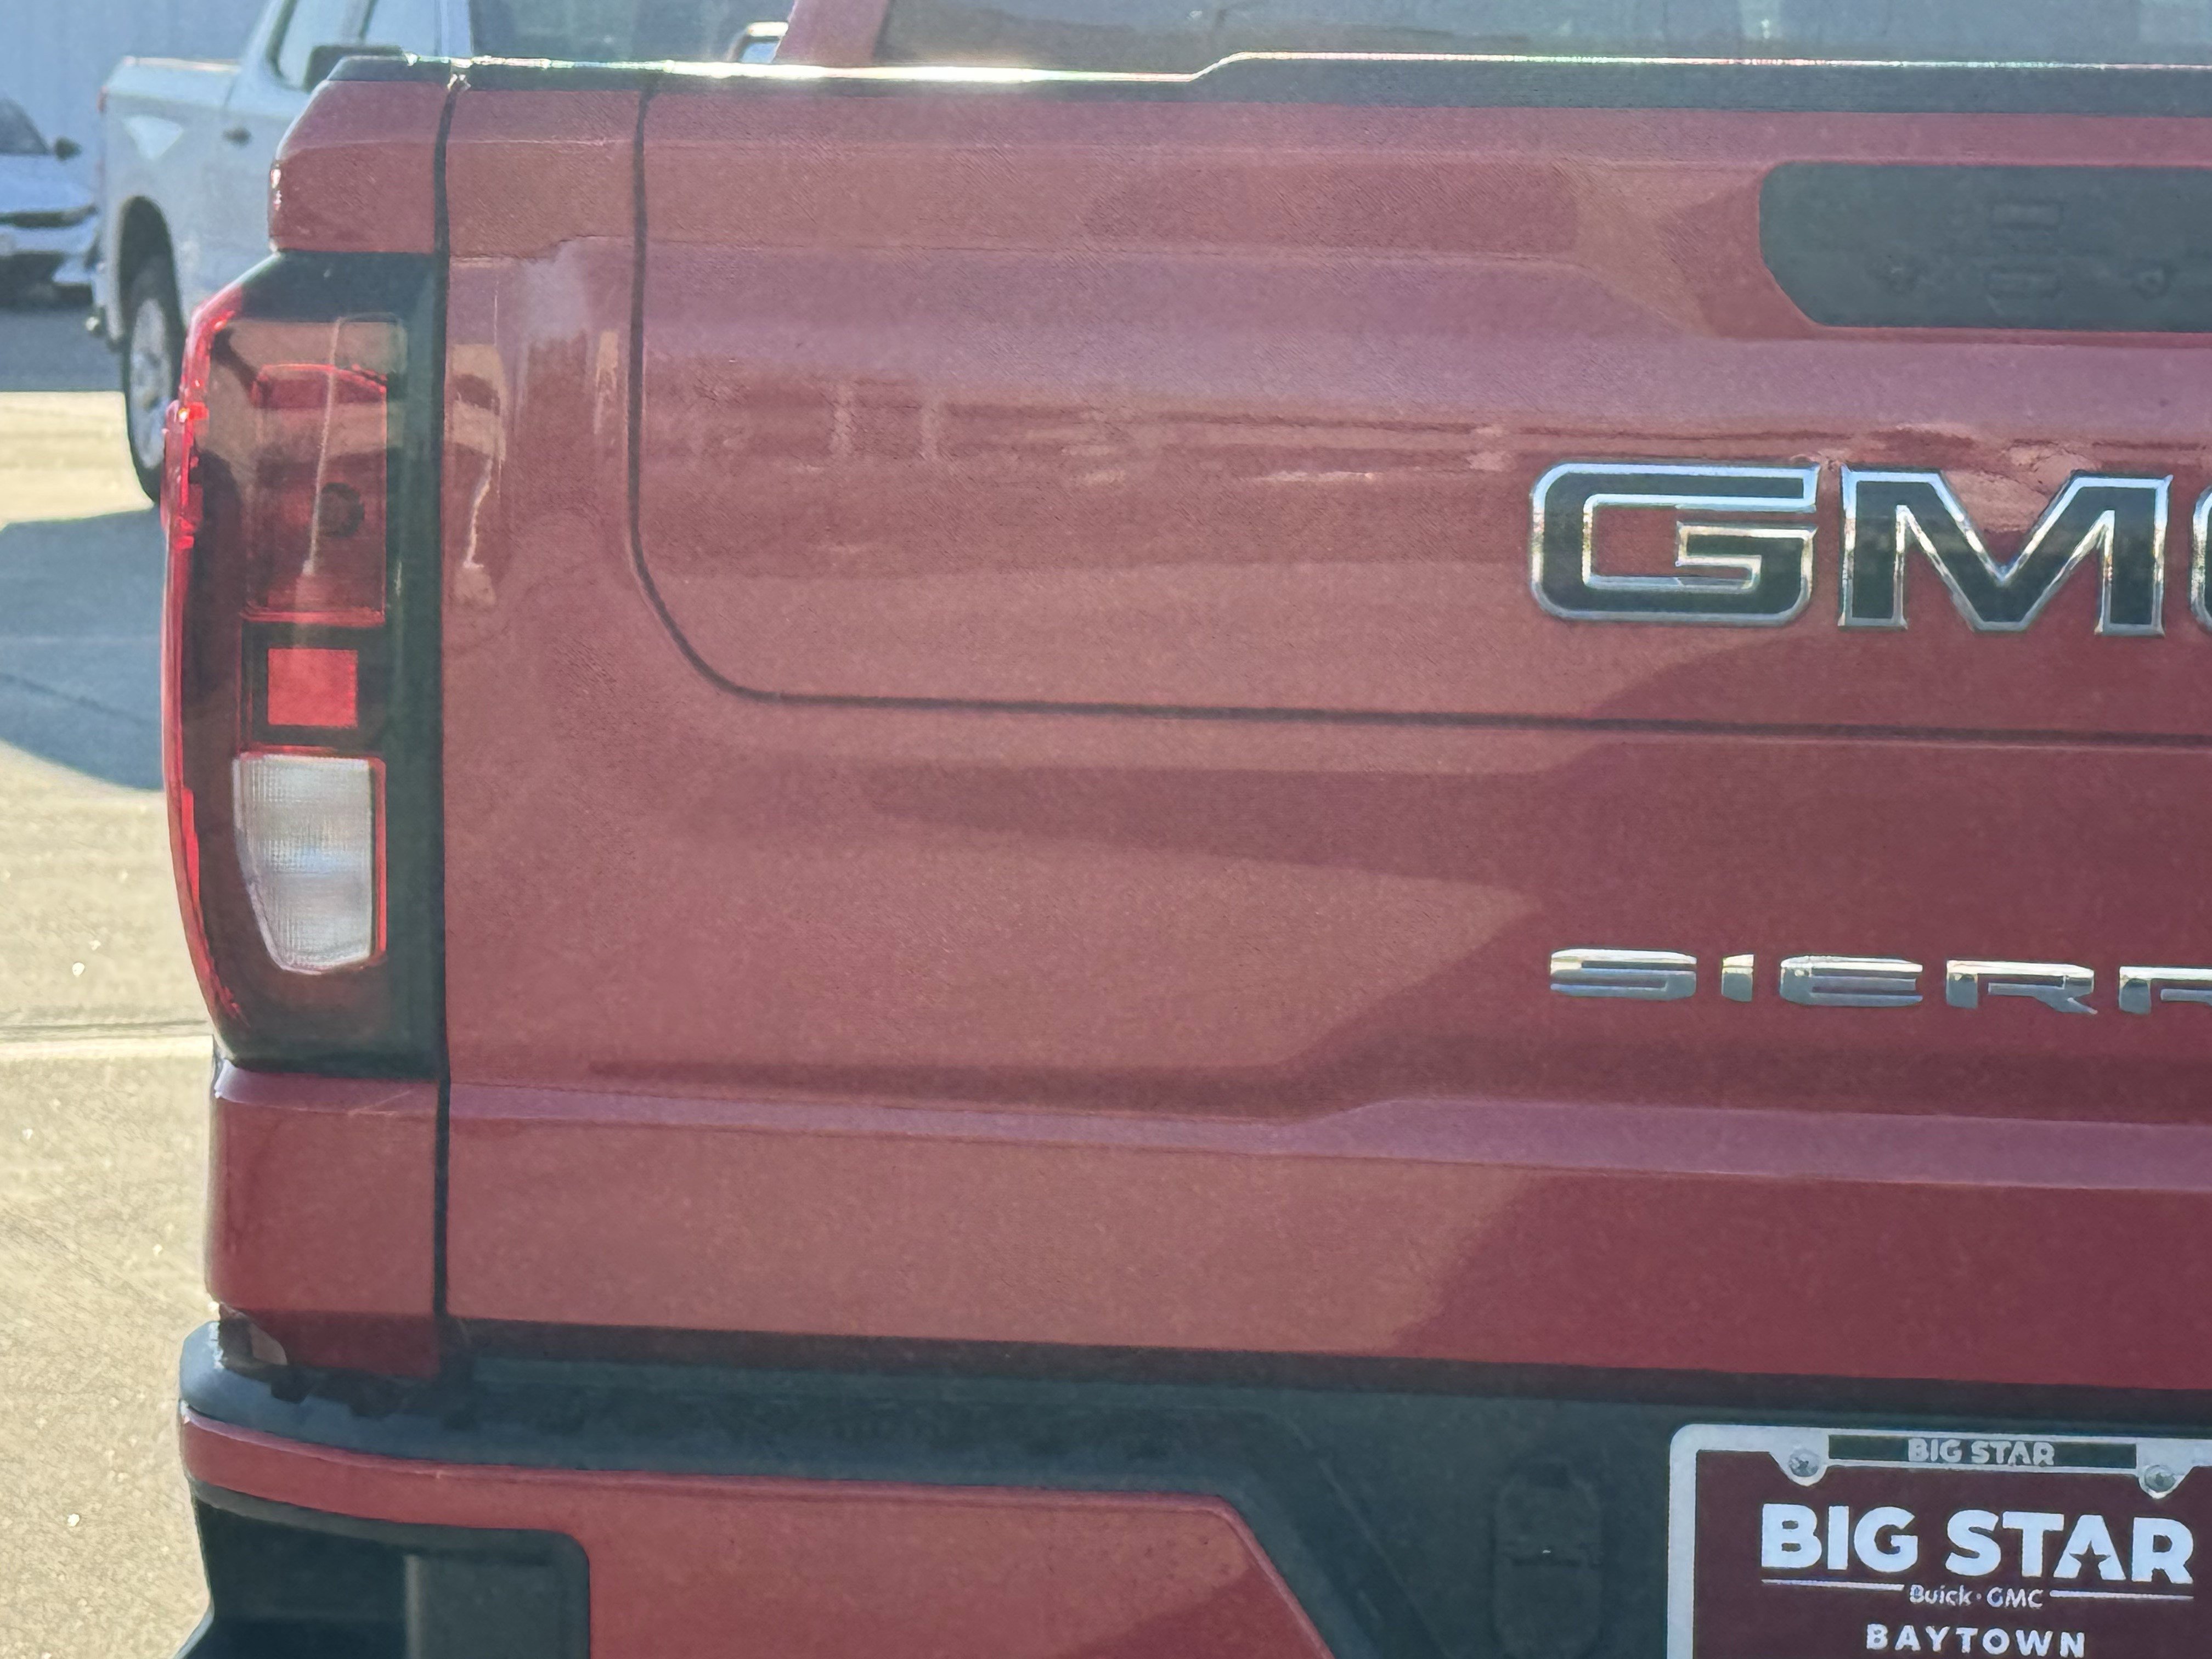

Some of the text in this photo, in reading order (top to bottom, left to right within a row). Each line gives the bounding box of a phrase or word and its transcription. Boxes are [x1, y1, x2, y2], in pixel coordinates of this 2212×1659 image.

[1530, 462, 2212, 637] GM
[1908, 1437, 2055, 1466] BIG STAR
[1761, 1503, 2194, 1584] BIG STAR
[1909, 1584, 2044, 1609] Buick GMC
[1865, 1623, 2086, 1658] BAYTOWN
